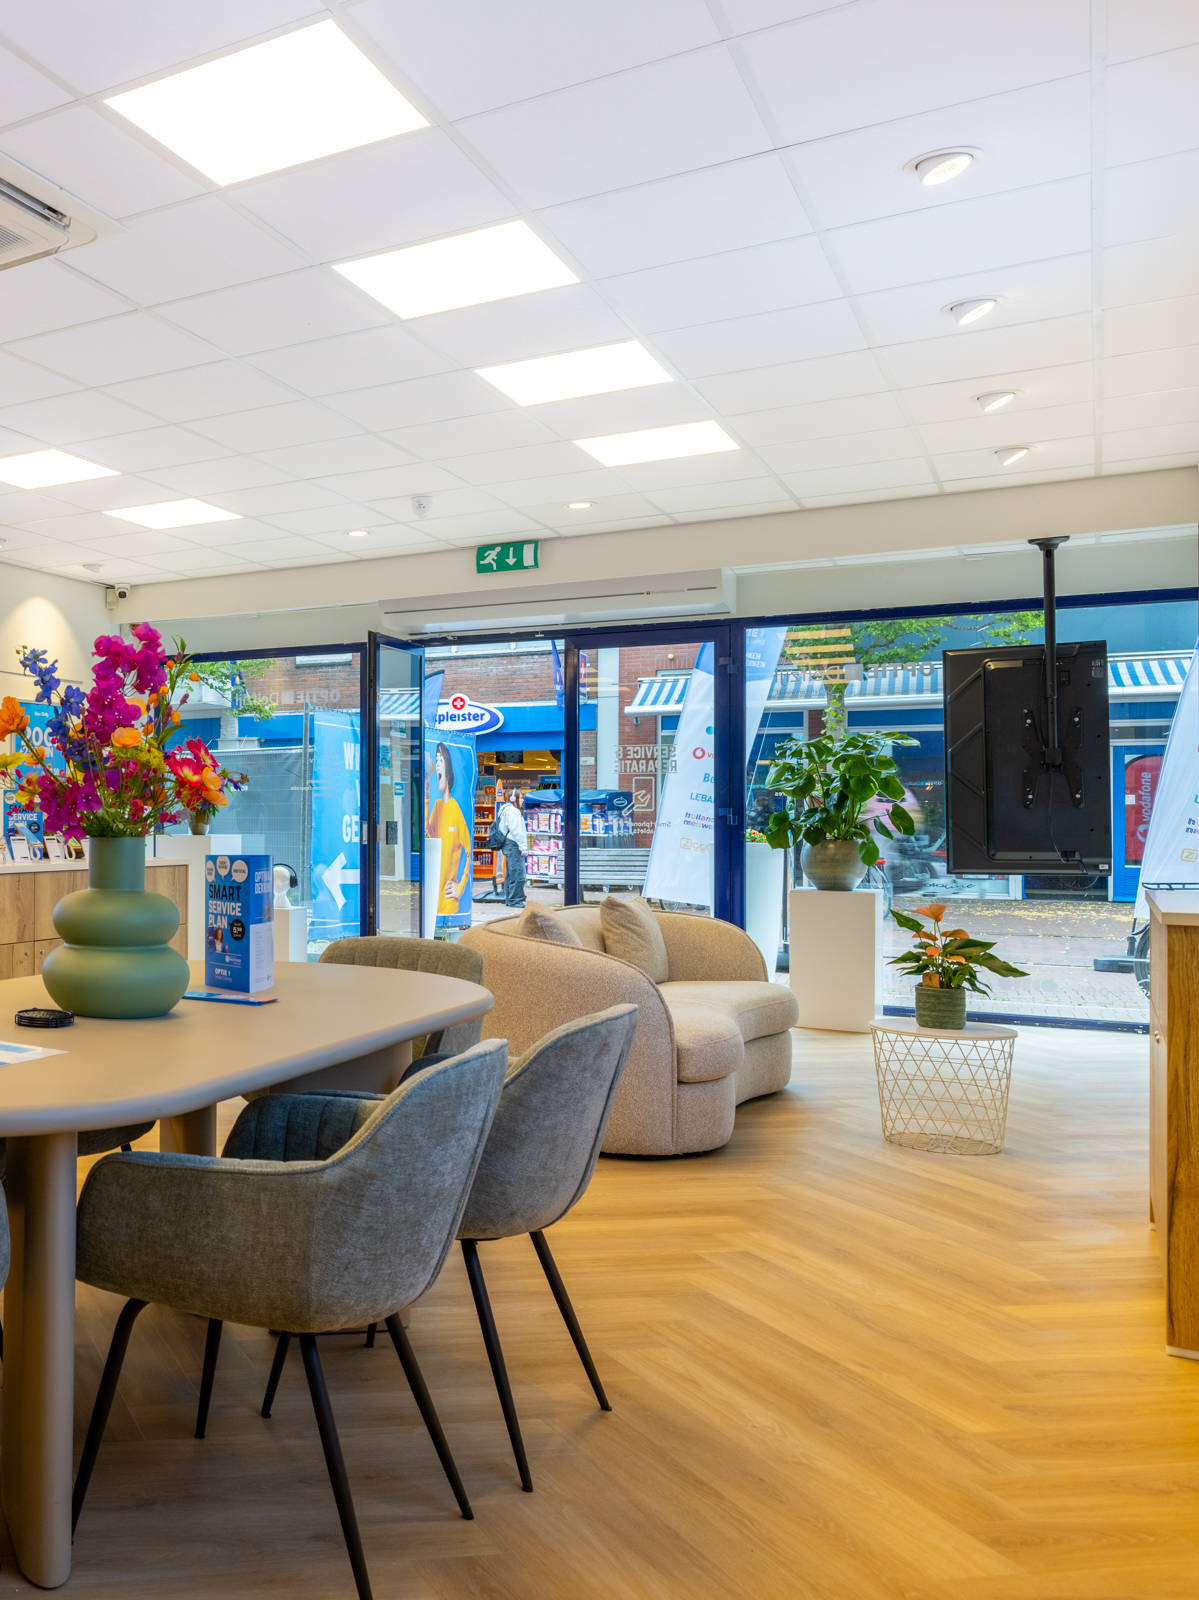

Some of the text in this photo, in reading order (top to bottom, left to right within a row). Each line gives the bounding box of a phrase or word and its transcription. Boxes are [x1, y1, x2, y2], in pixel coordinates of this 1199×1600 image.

[435, 711, 486, 724] pleister
[1138, 771, 1152, 822] vodafone
[208, 884, 242, 901] SMART
[208, 900, 242, 916] SERVICE
[208, 914, 228, 929] PLAN
[214, 968, 228, 976] OPTIE
